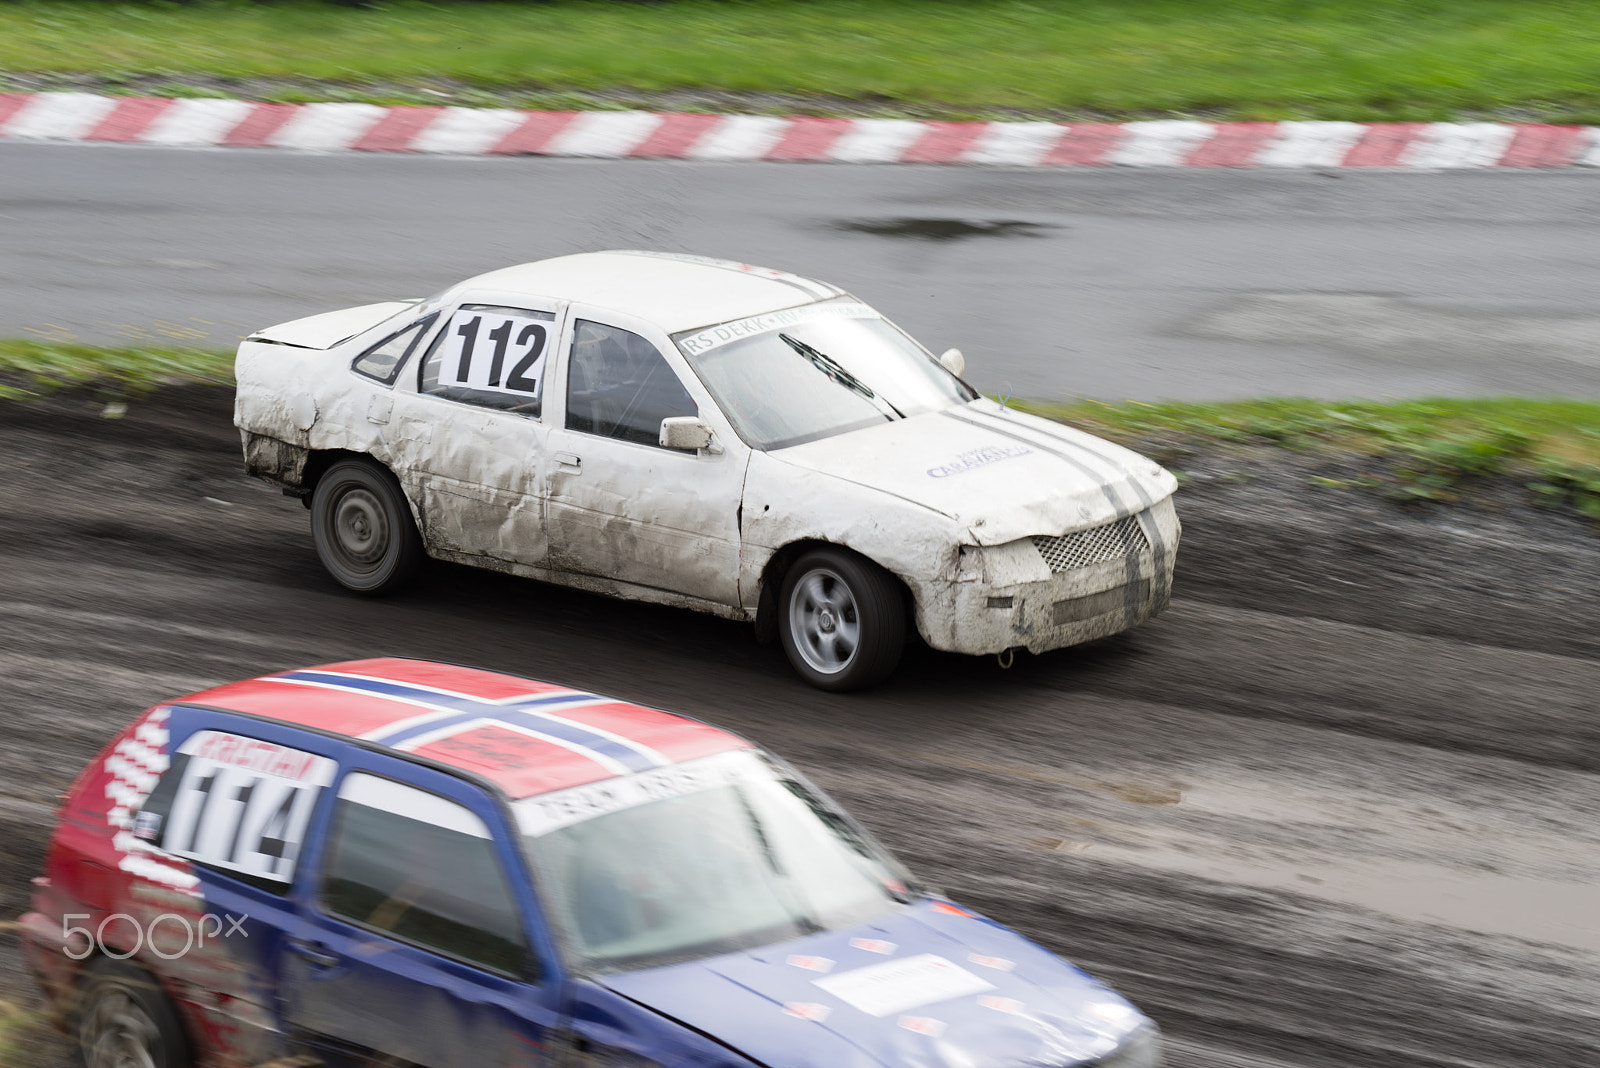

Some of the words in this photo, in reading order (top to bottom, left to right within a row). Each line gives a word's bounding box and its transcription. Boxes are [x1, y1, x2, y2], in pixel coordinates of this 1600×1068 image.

[456, 315, 547, 393] 112
[684, 333, 714, 353] RS
[715, 316, 770, 342] DEKK
[186, 766, 305, 874] 114
